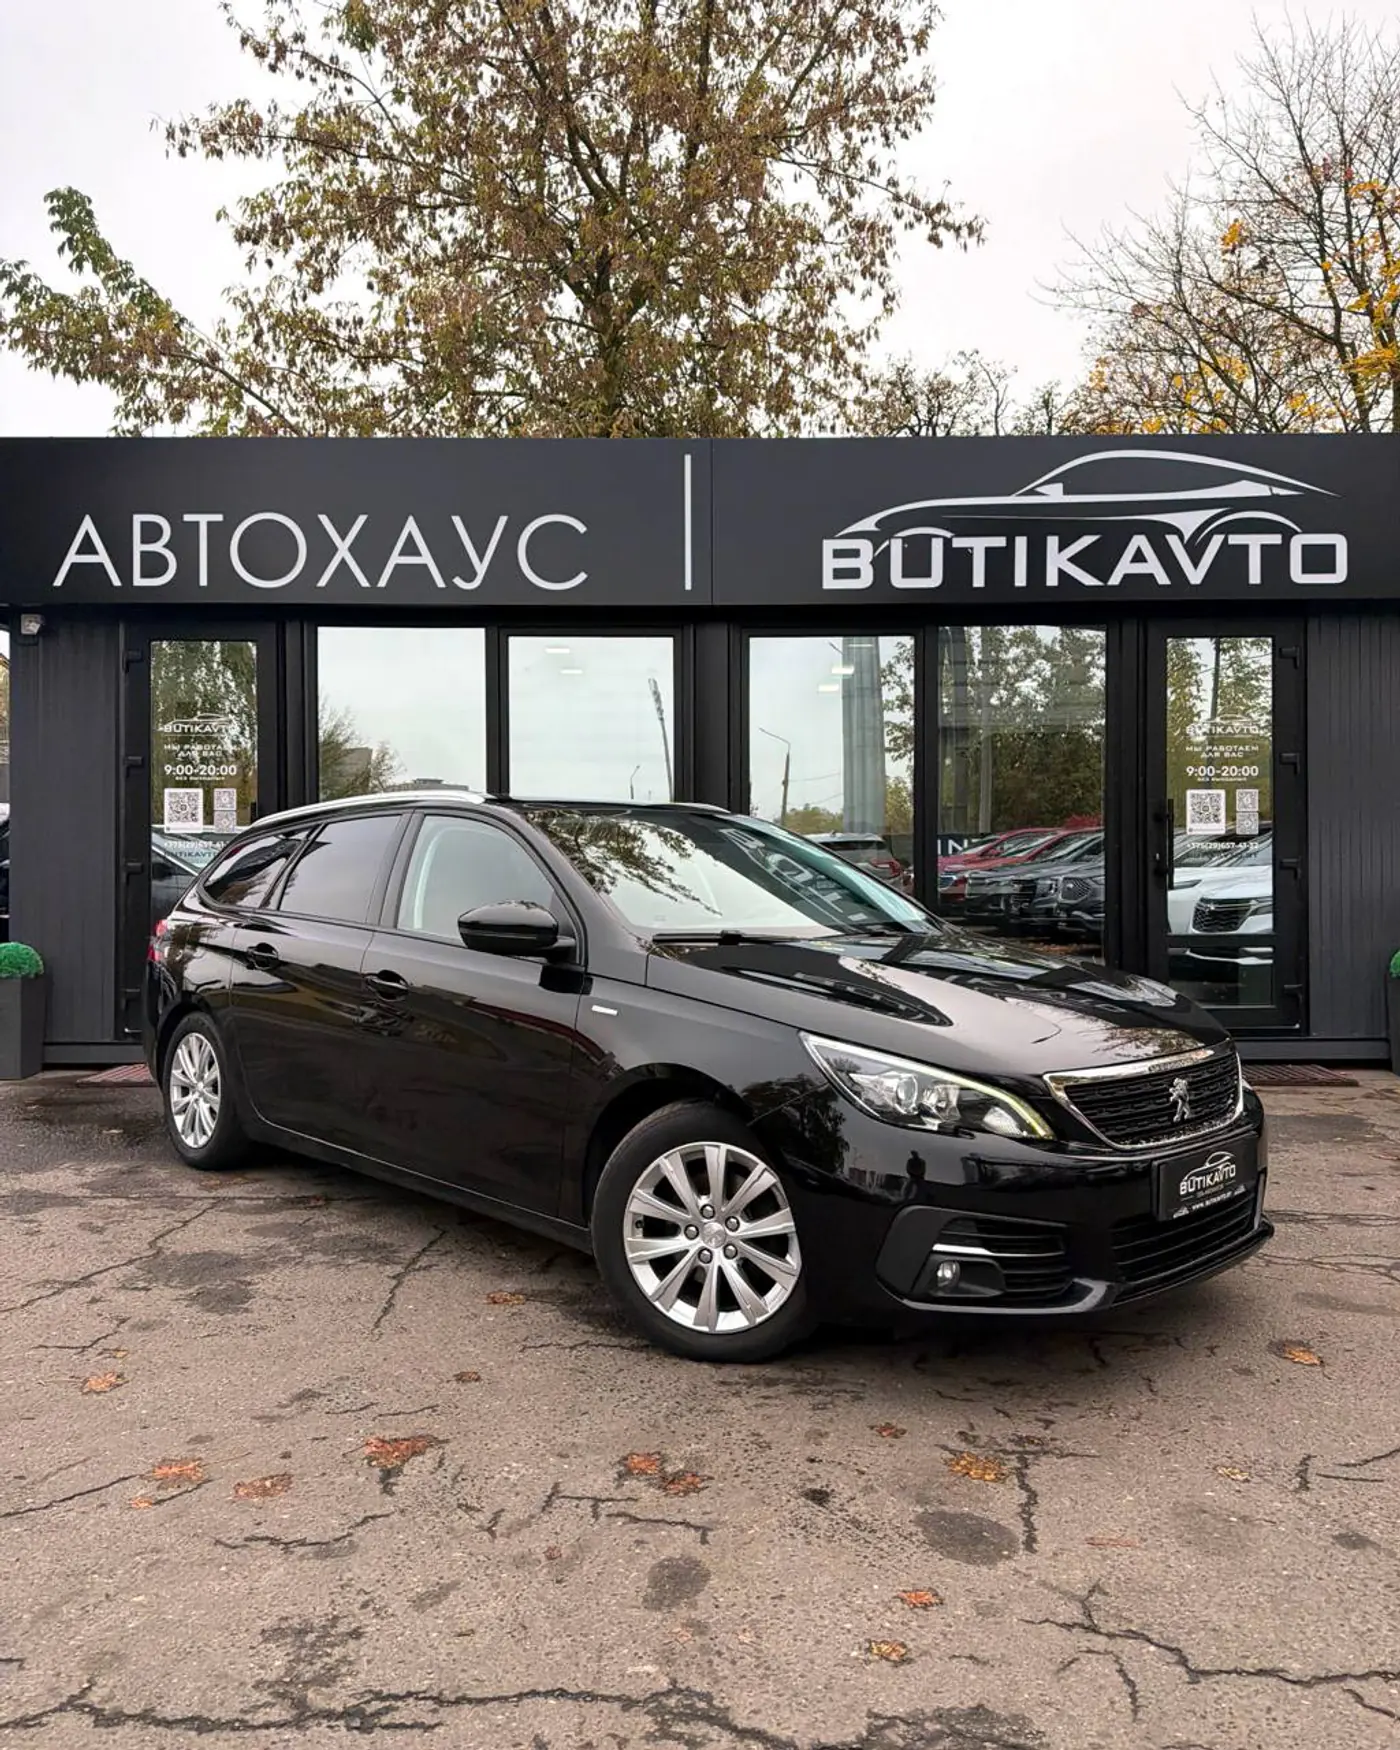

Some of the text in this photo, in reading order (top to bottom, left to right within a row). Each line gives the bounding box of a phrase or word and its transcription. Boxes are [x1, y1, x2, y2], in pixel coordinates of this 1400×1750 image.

[53, 512, 588, 590] АВТОХАУС
[822, 532, 1348, 590] BUTIKAVTO
[1206, 744, 1259, 752] РАБОТАЕМ
[164, 764, 237, 776] 9:00-20:00
[1186, 765, 1259, 777] 9:00-20:00
[1180, 1164, 1236, 1195] BUTIKAVTO
